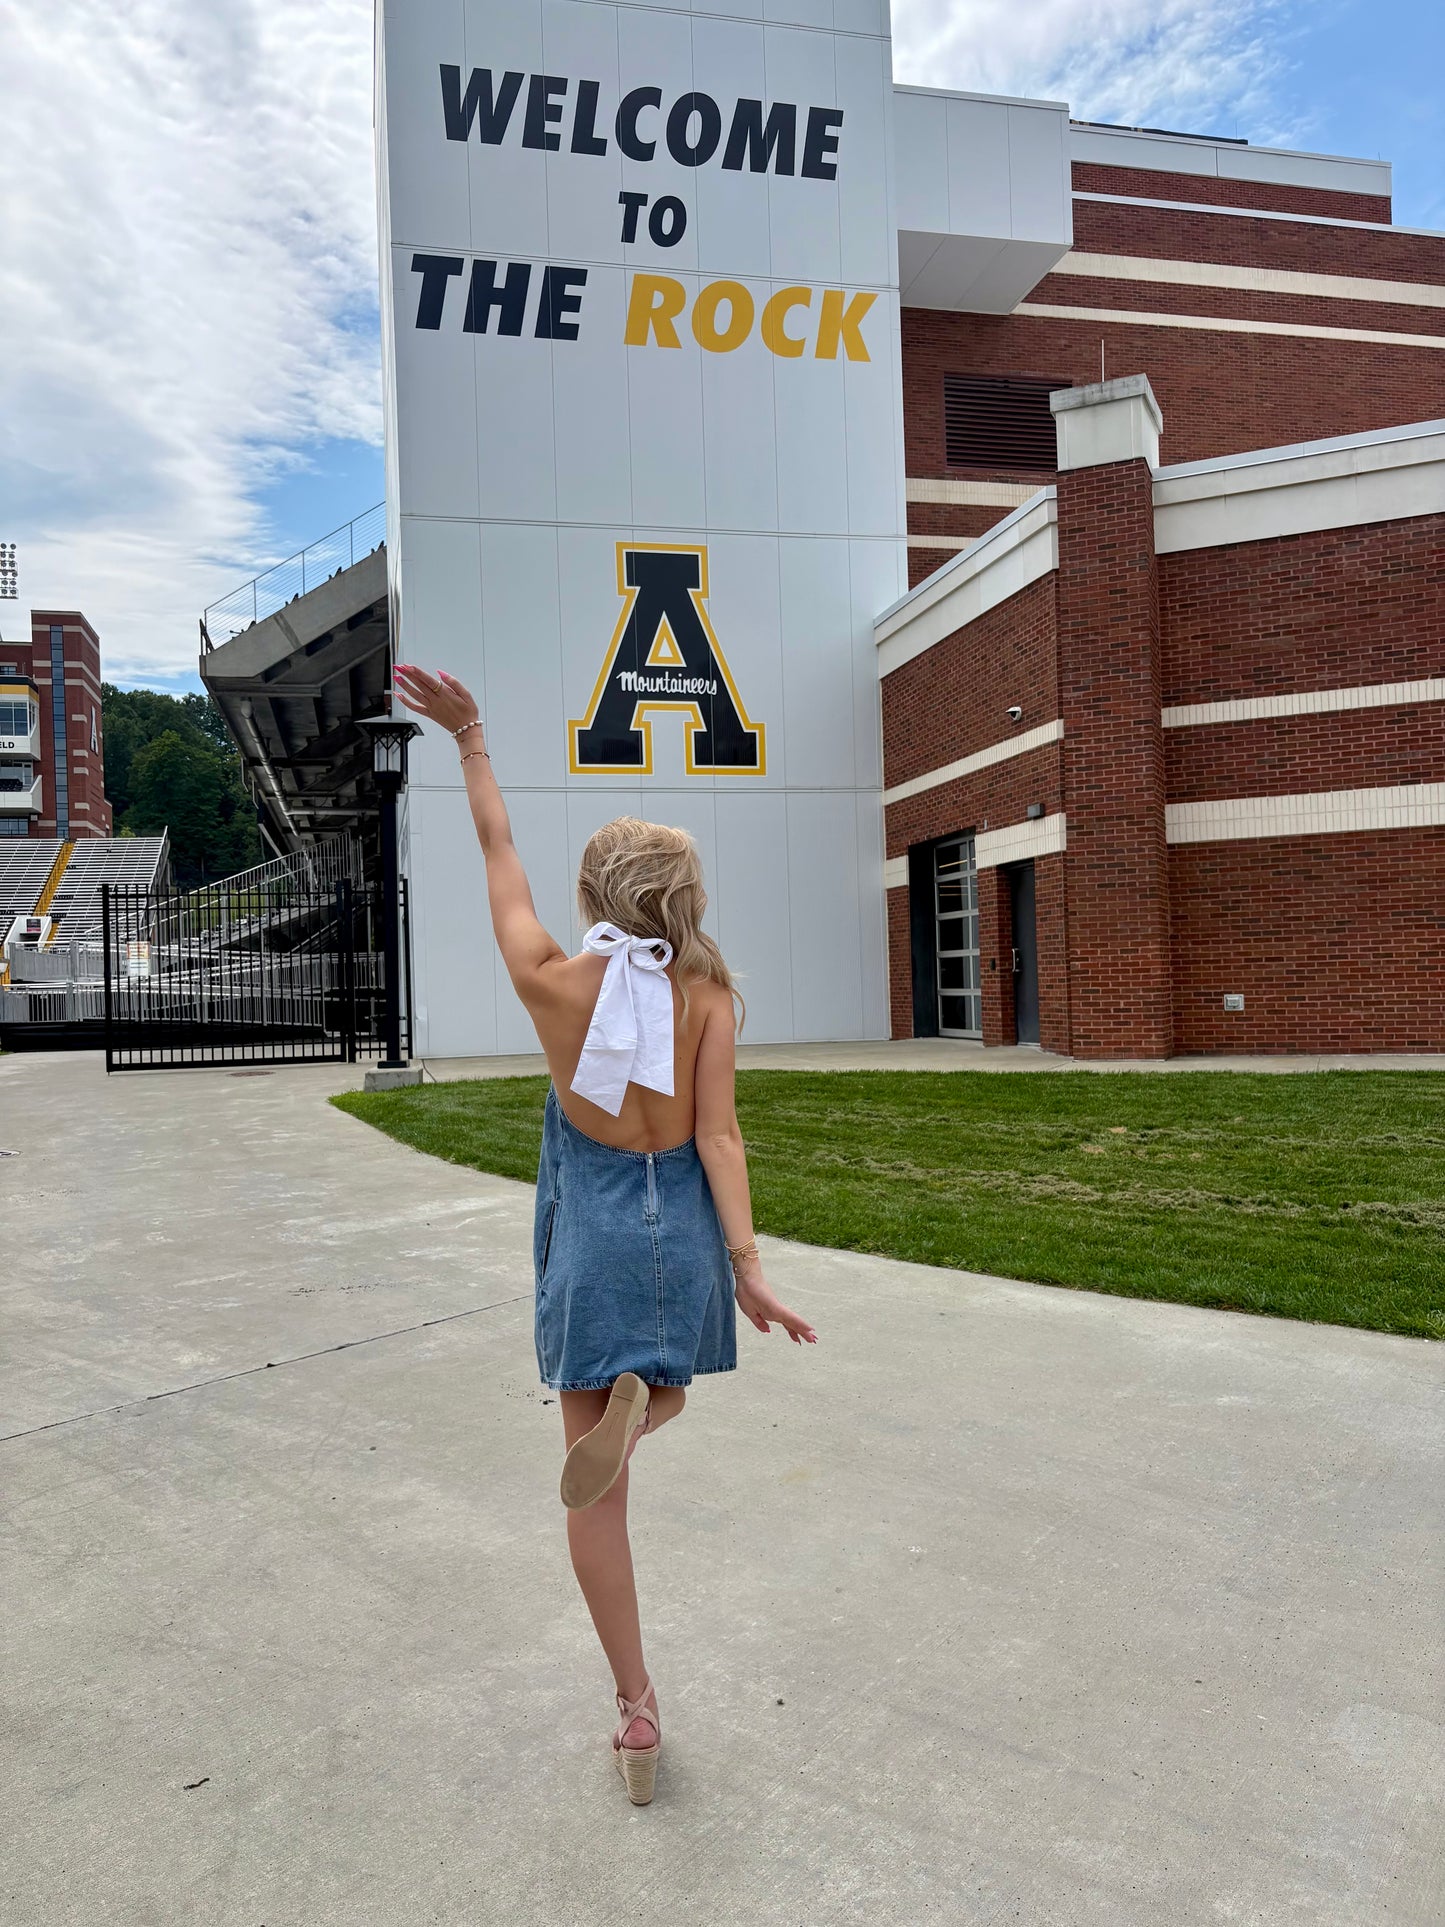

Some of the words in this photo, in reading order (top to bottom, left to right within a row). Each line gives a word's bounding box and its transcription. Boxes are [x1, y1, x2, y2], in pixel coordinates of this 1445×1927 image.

[440, 64, 844, 181] WELCOME
[618, 191, 687, 247] TO
[411, 254, 588, 340] THE
[624, 273, 878, 362] ROCK
[568, 541, 767, 776] A
[616, 671, 717, 695] Mountaineers
